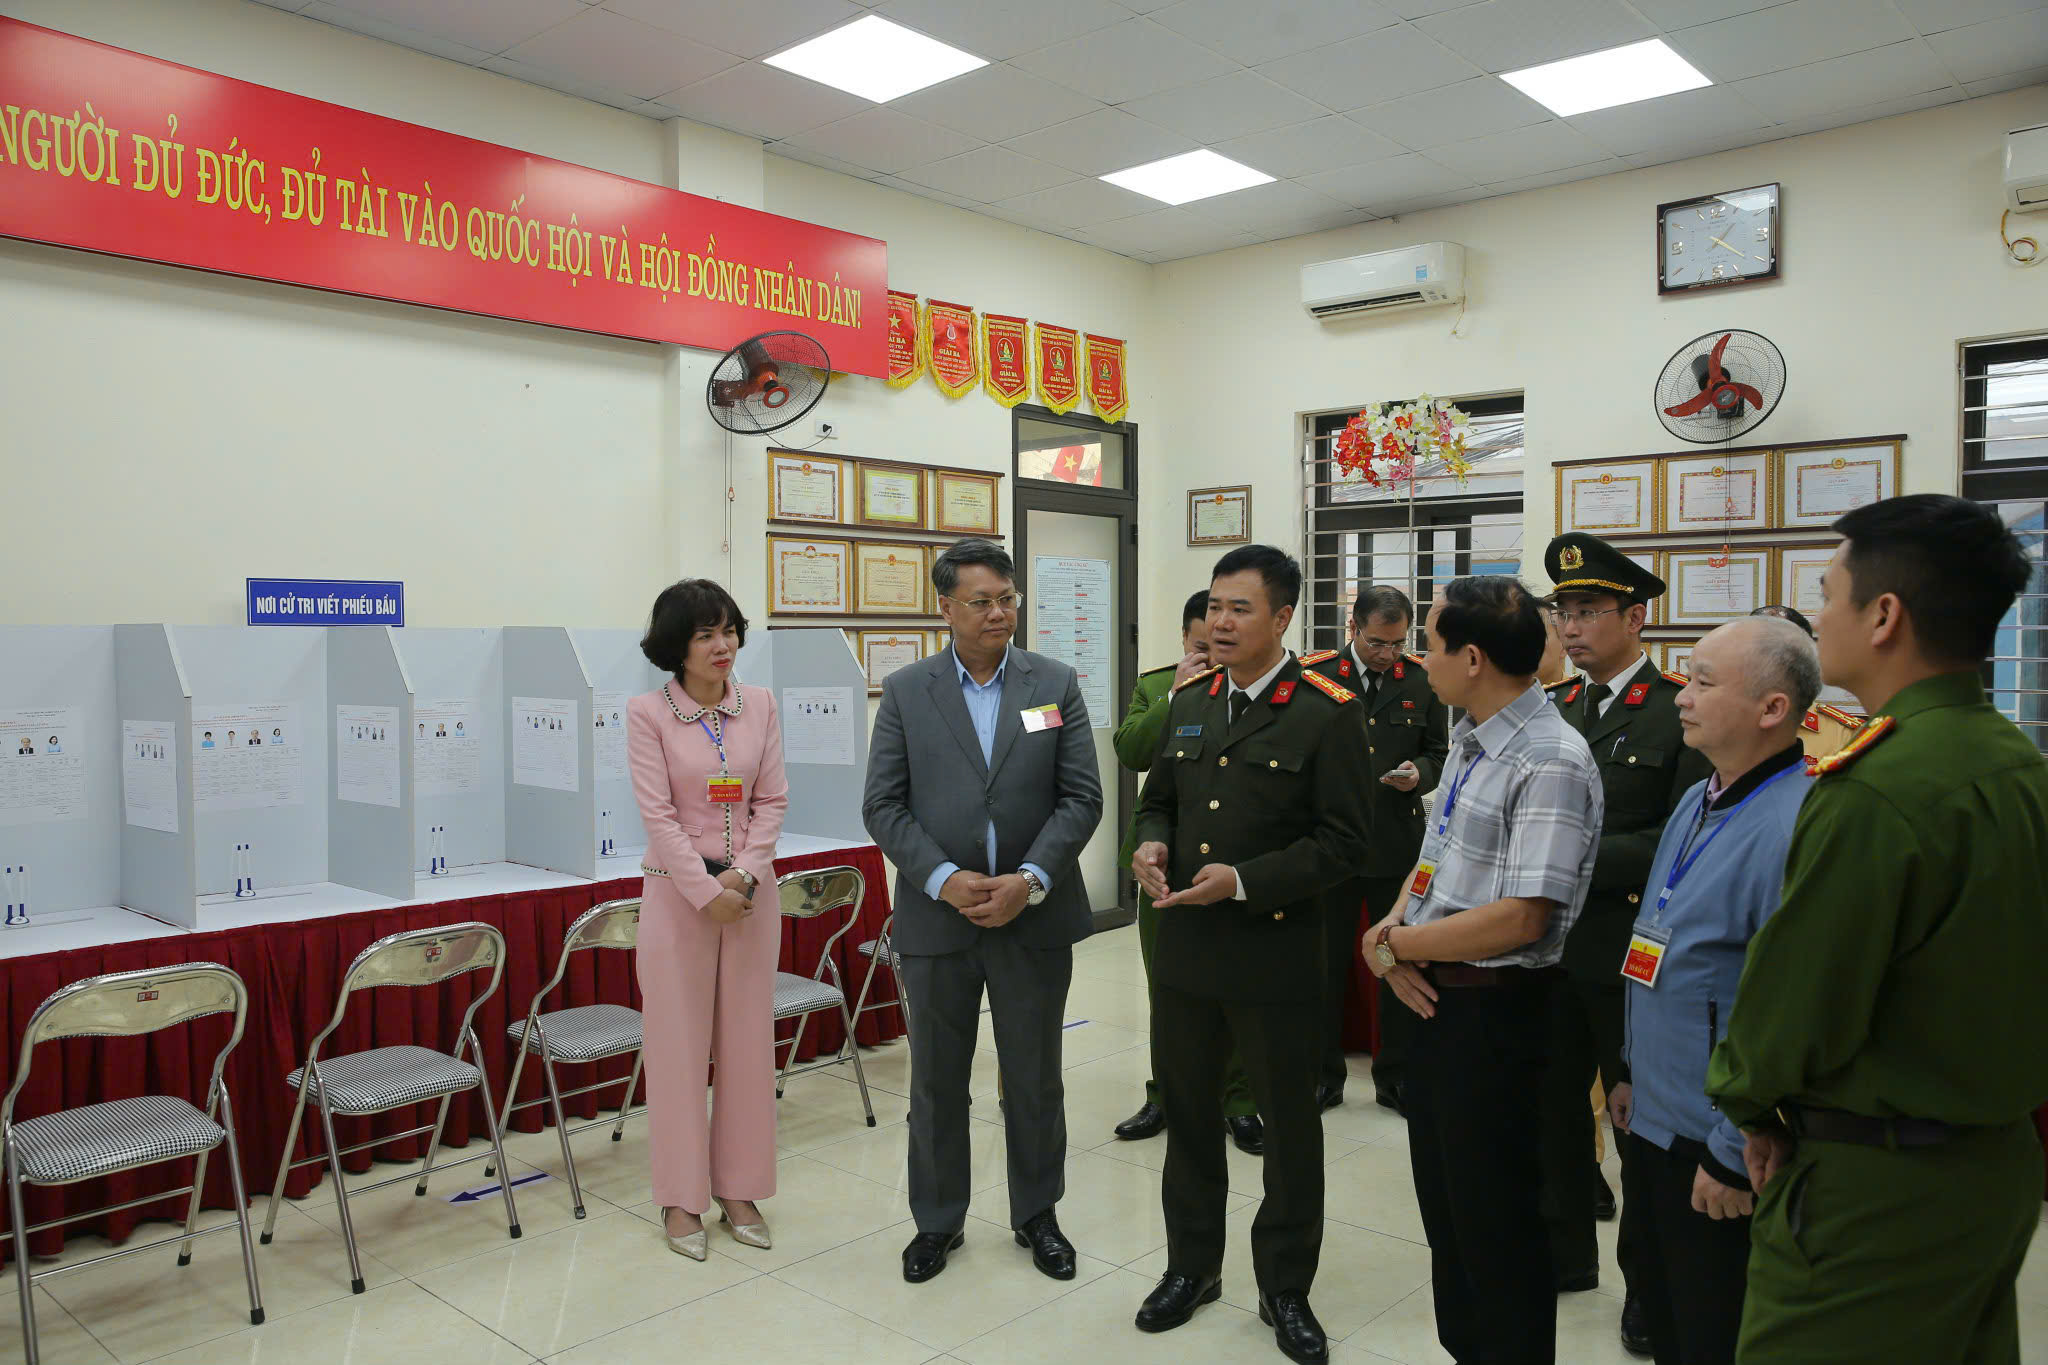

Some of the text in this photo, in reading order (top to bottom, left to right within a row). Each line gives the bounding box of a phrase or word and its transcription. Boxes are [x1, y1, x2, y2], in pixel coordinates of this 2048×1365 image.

[0, 102, 862, 330] NGƯỜI ĐỦ ĐỨC, ĐỦ TÀI VÀO QUỐC HỘI VÀ HỘI ĐỒNG NHÂN DÂN!
[256, 591, 396, 615] NƠI CỬ TRI VIẾT PHIẾU BẦU
